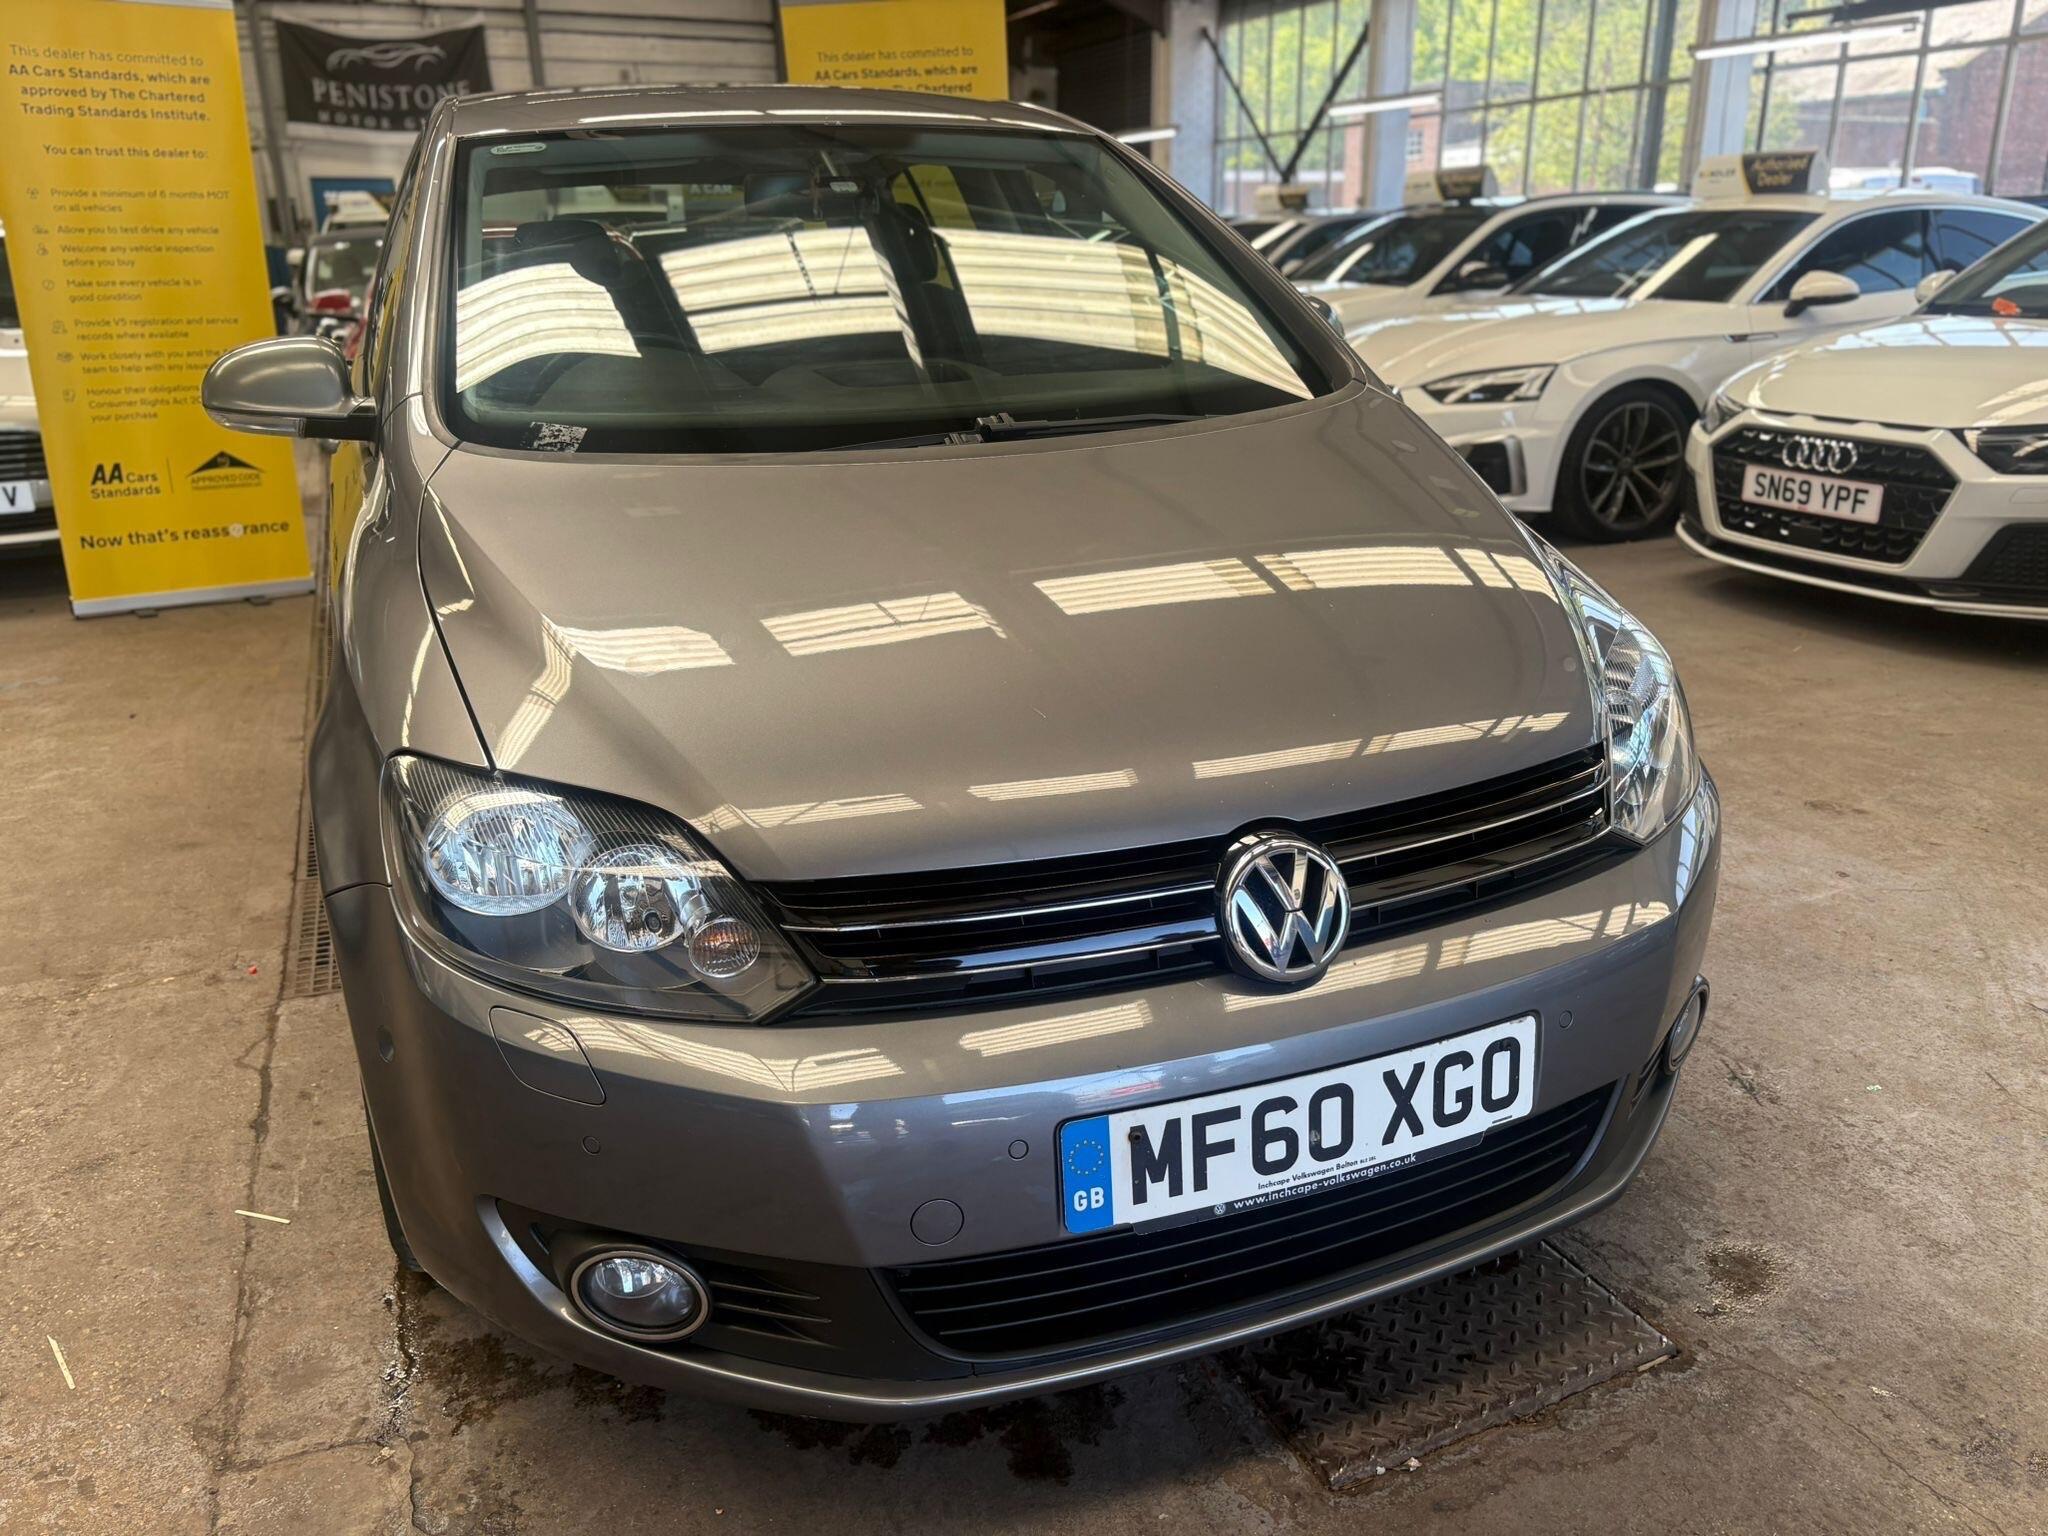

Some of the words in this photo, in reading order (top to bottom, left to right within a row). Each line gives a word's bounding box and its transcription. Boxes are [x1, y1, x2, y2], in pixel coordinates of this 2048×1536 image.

[9, 44, 39, 57] This
[43, 47, 86, 61] dealer
[89, 49, 113, 62] has
[117, 51, 187, 66] committed
[190, 56, 203, 67] to
[817, 52, 839, 64] This
[842, 50, 877, 62] dealer
[878, 50, 897, 60] has
[900, 47, 958, 60] committed
[961, 47, 973, 57] to
[9, 64, 30, 76] AA
[33, 66, 65, 78] Cars
[68, 67, 144, 83] Standards,
[147, 72, 186, 84] which
[190, 75, 210, 85] are
[815, 70, 831, 81] AA
[833, 69, 858, 80] Cars
[862, 66, 921, 79] Standards,
[924, 65, 958, 76] which
[961, 65, 978, 75] are
[21, 86, 87, 99] approved
[90, 88, 107, 101] by
[110, 88, 135, 101] The
[139, 89, 205, 103] Chartered
[312, 77, 471, 110] PENISTONE
[22, 104, 75, 118] Trading
[78, 105, 147, 119] Standards
[150, 108, 210, 121] Institute.
[318, 110, 390, 130] MOTOR
[43, 144, 67, 156] You
[70, 147, 92, 157] can
[95, 146, 125, 158] trust
[127, 146, 150, 158] this
[152, 147, 189, 159] dealer
[192, 148, 208, 159] to:
[50, 187, 90, 198] Provide
[100, 188, 146, 199] minimum
[148, 188, 158, 198] of
[169, 190, 205, 200] months
[207, 190, 229, 200] MOT
[53, 204, 66, 212] on
[68, 203, 81, 212] all
[83, 203, 123, 213] vehicles
[57, 225, 87, 235] Allow
[89, 227, 105, 237] you
[107, 225, 118, 235] to
[120, 225, 137, 235] test
[139, 225, 164, 235] drive
[167, 227, 184, 237] any
[187, 225, 219, 235] vehicle
[60, 244, 108, 253] Welcome
[110, 246, 127, 255] any
[129, 243, 162, 253] vehicle
[165, 244, 215, 256] inspection
[62, 257, 95, 267] before
[97, 260, 115, 270] you
[117, 258, 135, 269] buy
[66, 279, 93, 288] Make
[95, 280, 117, 288] sure
[119, 280, 145, 290] every
[147, 278, 181, 287] vehicle
[69, 293, 94, 303] good
[96, 292, 142, 302] condition
[74, 318, 111, 328] Provide
[114, 317, 127, 327] V5
[129, 316, 184, 328] registration
[187, 316, 204, 326] and
[206, 316, 239, 325] service
[77, 330, 114, 341] records
[116, 330, 145, 340] where
[148, 329, 188, 339] available
[80, 351, 105, 361] Work
[107, 350, 141, 362] closely
[143, 350, 163, 360] with
[167, 351, 184, 360] you
[186, 349, 204, 358] and
[86, 386, 123, 396] Honour
[124, 385, 146, 395] their
[148, 384, 199, 395] obligations
[91, 413, 111, 423] your
[113, 411, 158, 422] purchase
[91, 463, 123, 486] AA
[126, 472, 158, 483] Cars
[2, 486, 17, 507] V
[90, 485, 161, 500] Standards
[1753, 472, 1812, 505] SN69
[1820, 482, 1870, 514] YPF
[80, 534, 123, 550] Now
[128, 528, 179, 546] that's
[183, 520, 290, 541] reassrance
[1129, 1082, 1354, 1206] MF60
[1382, 1036, 1521, 1146] XGO
[1233, 1153, 1417, 1209] www.inchcape-volkswagen.co.uk
[1257, 1178, 1291, 1190] Inchcape
[1291, 1166, 1335, 1183] Volkswagen
[1335, 1160, 1359, 1171] Bolton
[1073, 1189, 1105, 1212] GB
